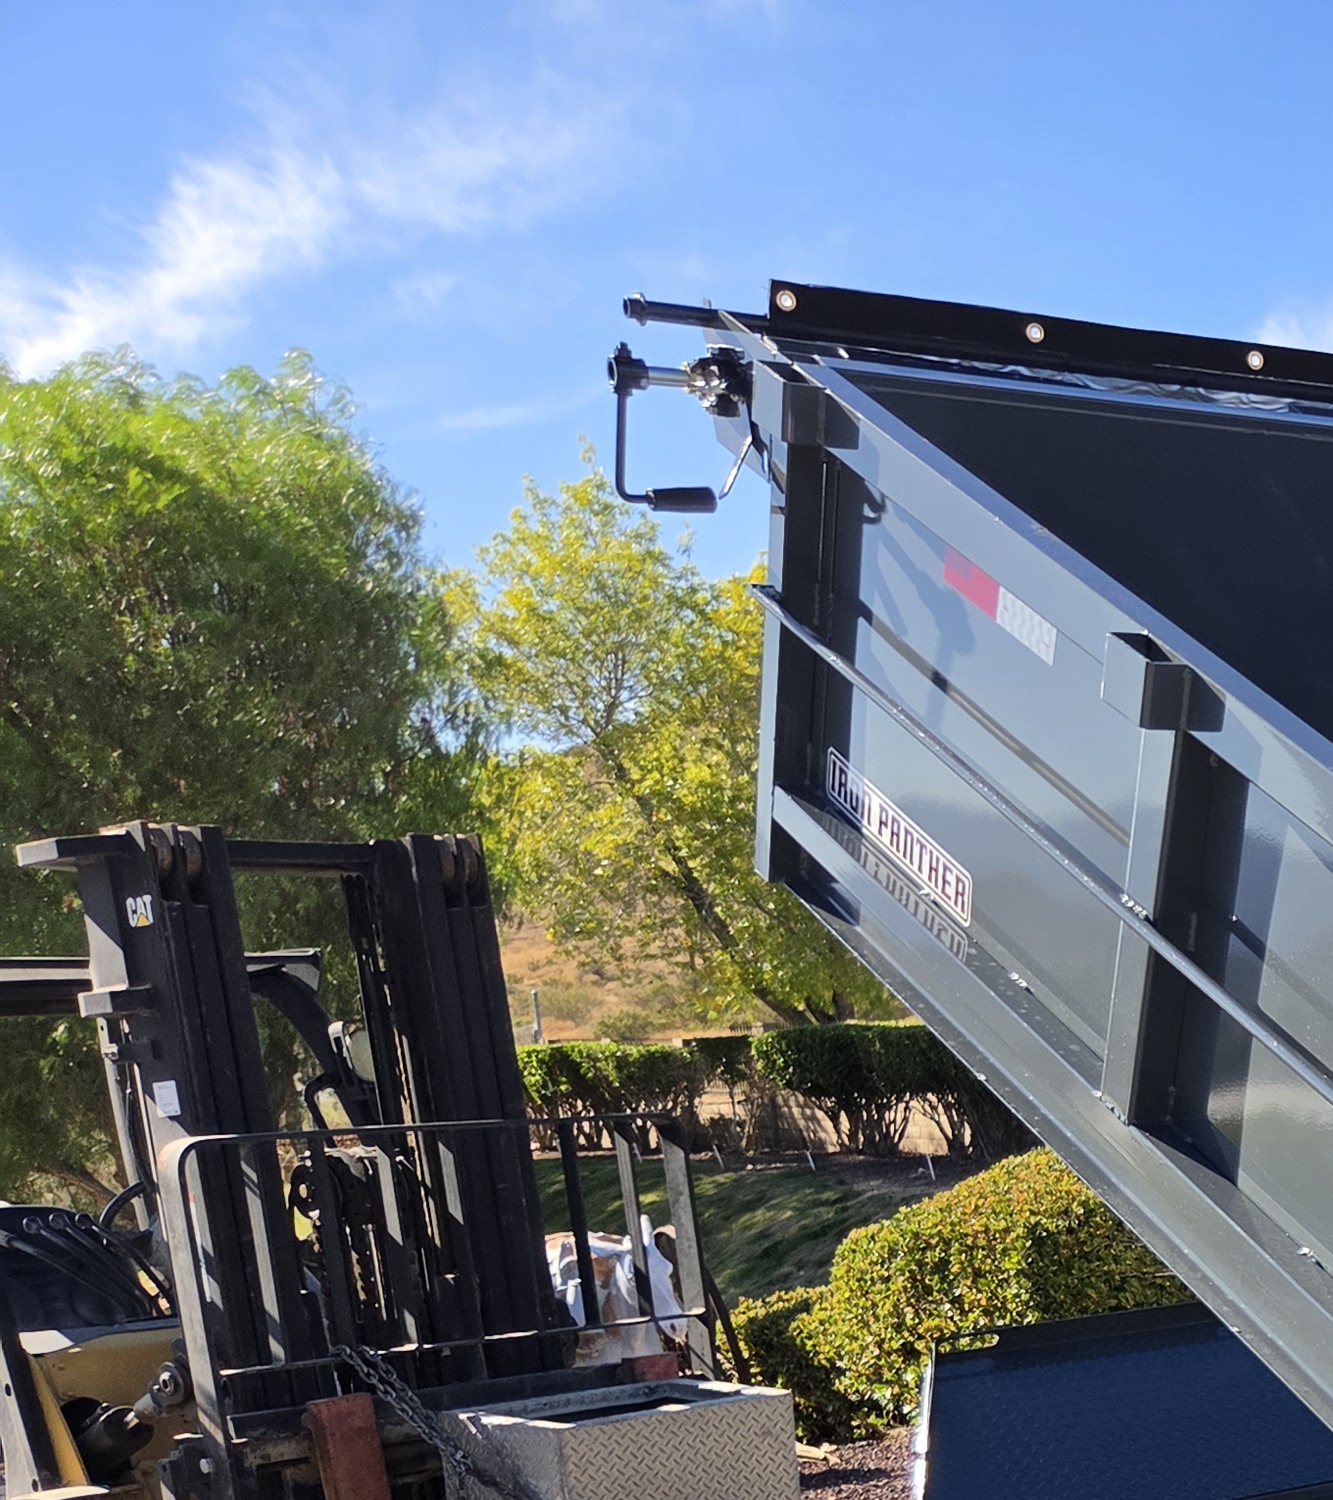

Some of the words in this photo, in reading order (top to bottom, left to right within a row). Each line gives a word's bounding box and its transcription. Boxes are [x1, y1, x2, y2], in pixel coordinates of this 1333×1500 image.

[831, 759, 872, 826] IRON
[878, 802, 968, 915] PANTHER
[125, 894, 154, 928] CAT
